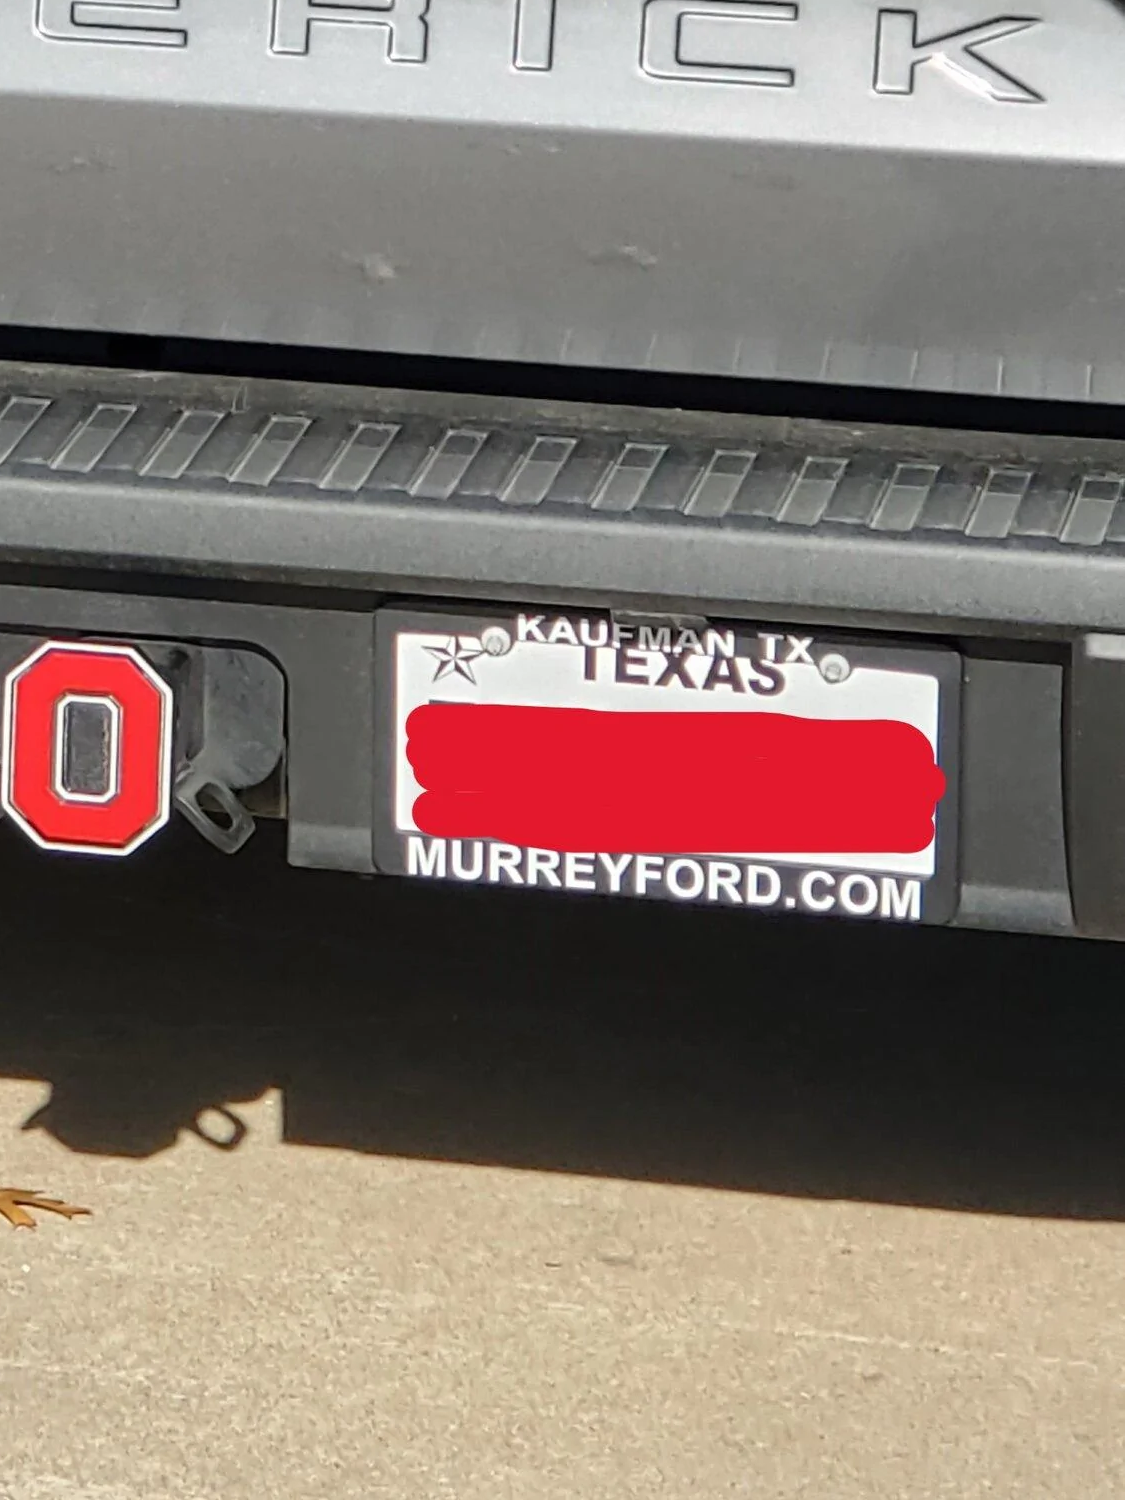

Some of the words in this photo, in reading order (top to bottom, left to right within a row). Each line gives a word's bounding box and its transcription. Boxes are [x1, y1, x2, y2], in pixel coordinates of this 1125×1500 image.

[516, 613, 735, 657] KAUFMAN
[758, 633, 814, 664] TX
[583, 646, 786, 697] TEXAS
[406, 836, 922, 921] MURREYFORD.COM
